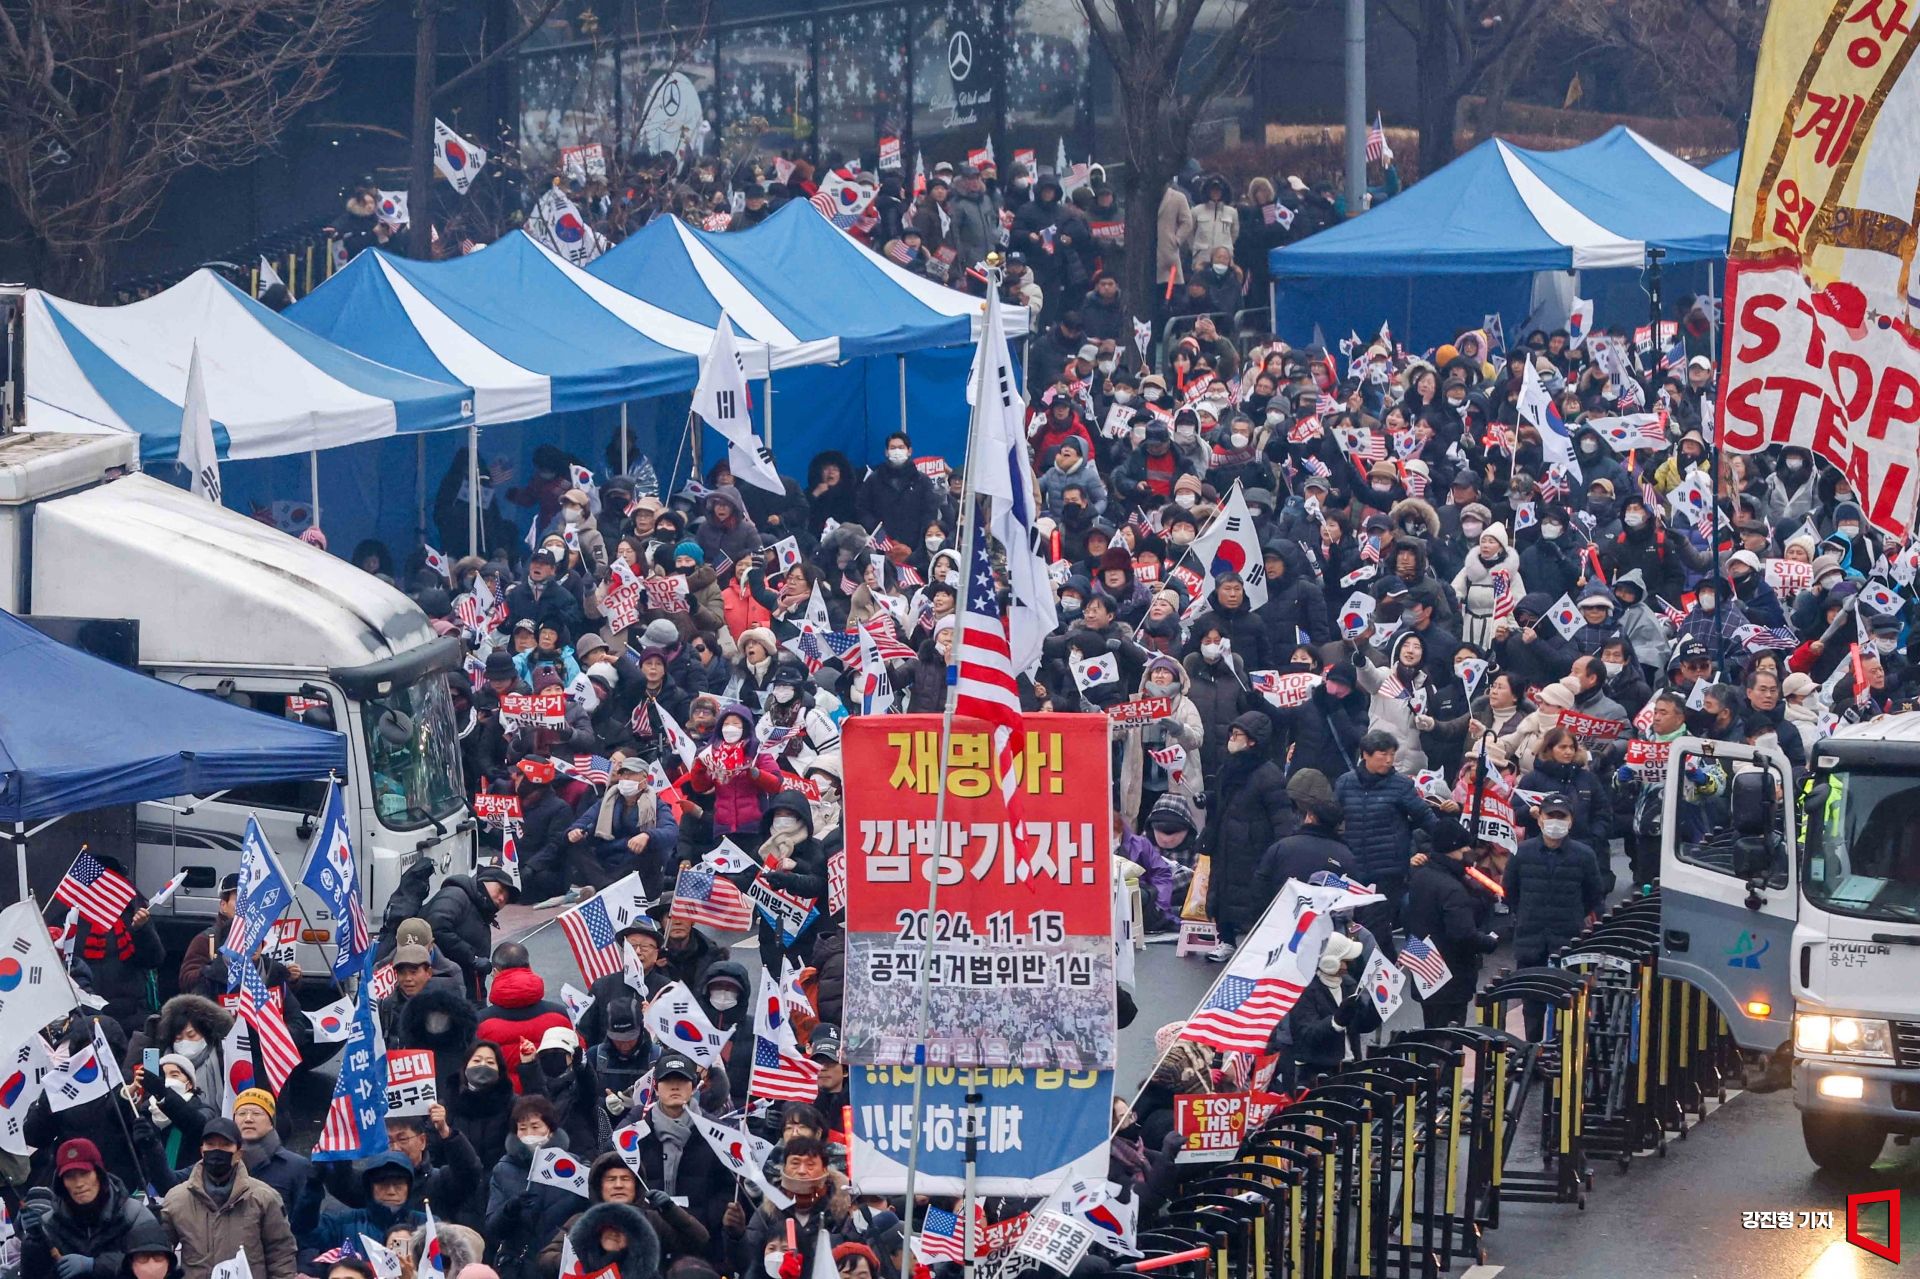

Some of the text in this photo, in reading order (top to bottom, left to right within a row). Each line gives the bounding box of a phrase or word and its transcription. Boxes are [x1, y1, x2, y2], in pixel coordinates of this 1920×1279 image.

[1737, 293, 1920, 442] STOP
[1724, 377, 1910, 538] STEAL
[1778, 574, 1811, 588] THE
[604, 582, 639, 609] STOP
[504, 695, 561, 712] 부정선거
[1278, 686, 1307, 704] THE
[520, 712, 544, 722] OUT
[1109, 698, 1168, 717] 부정선거
[1561, 713, 1621, 736] 부정선거
[1629, 743, 1670, 760] 부정선
[888, 731, 1063, 798] 재명아!
[475, 796, 519, 814] 부정선거
[899, 912, 1062, 946] 2024. 11. 15
[1829, 943, 1890, 956] HYUNDAI
[1828, 953, 1868, 968] 용산구
[1054, 956, 1091, 986] 1심
[387, 1053, 427, 1080] 반대
[1192, 1098, 1241, 1117] STOP
[1197, 1116, 1231, 1133] THE
[1189, 1131, 1240, 1150] STEAL
